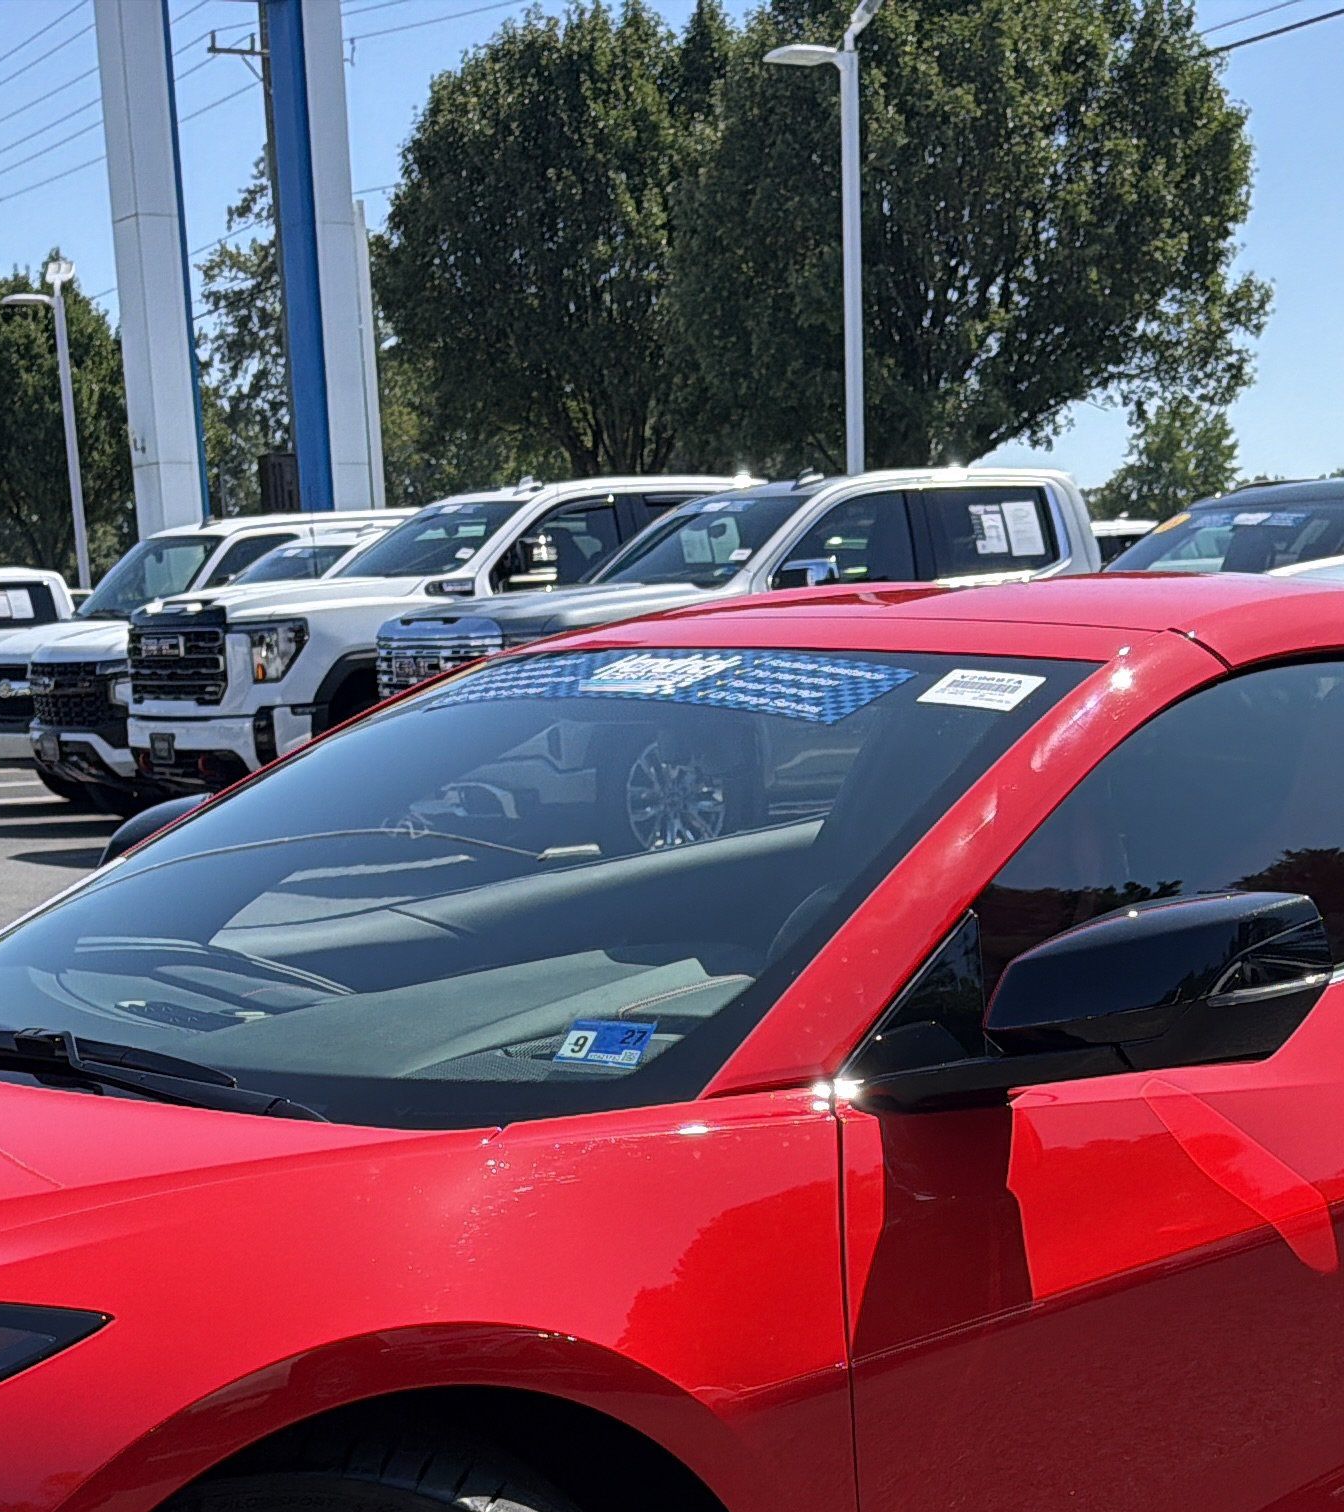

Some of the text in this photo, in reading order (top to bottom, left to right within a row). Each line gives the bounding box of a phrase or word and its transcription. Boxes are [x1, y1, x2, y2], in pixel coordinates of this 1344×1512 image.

[591, 653, 743, 681] Hendrick
[570, 1034, 589, 1054] 9
[619, 1029, 648, 1046] 27
